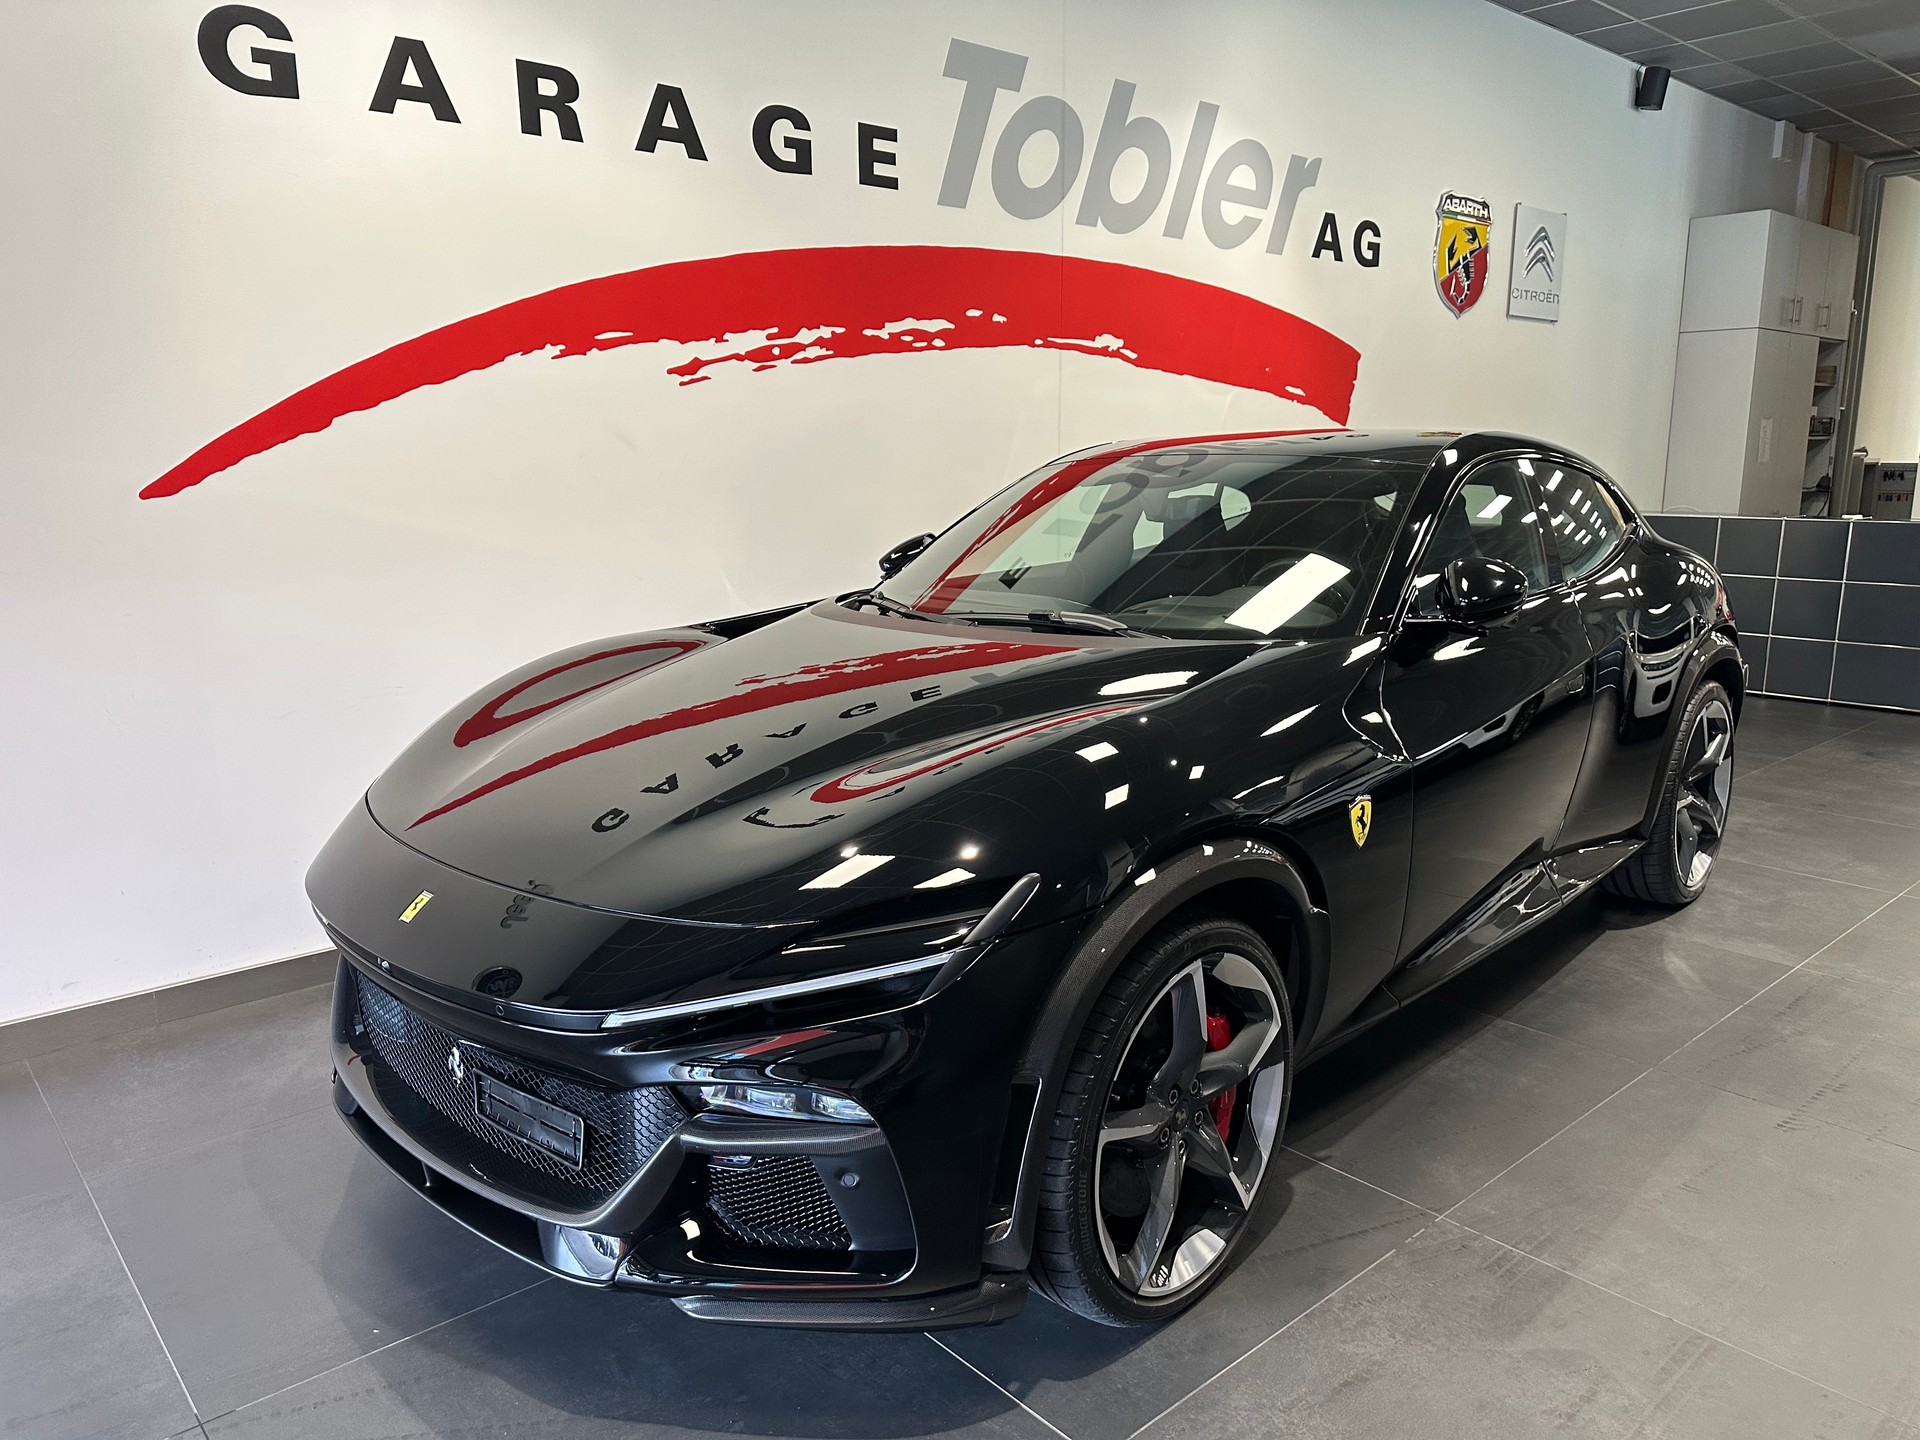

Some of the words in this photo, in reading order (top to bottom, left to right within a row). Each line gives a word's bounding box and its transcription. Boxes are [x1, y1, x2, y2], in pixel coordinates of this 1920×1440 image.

[197, 4, 899, 191] GARAGE
[937, 37, 1323, 256] Tobler
[1311, 212, 1382, 268] AG
[1443, 198, 1488, 219] ABARTH
